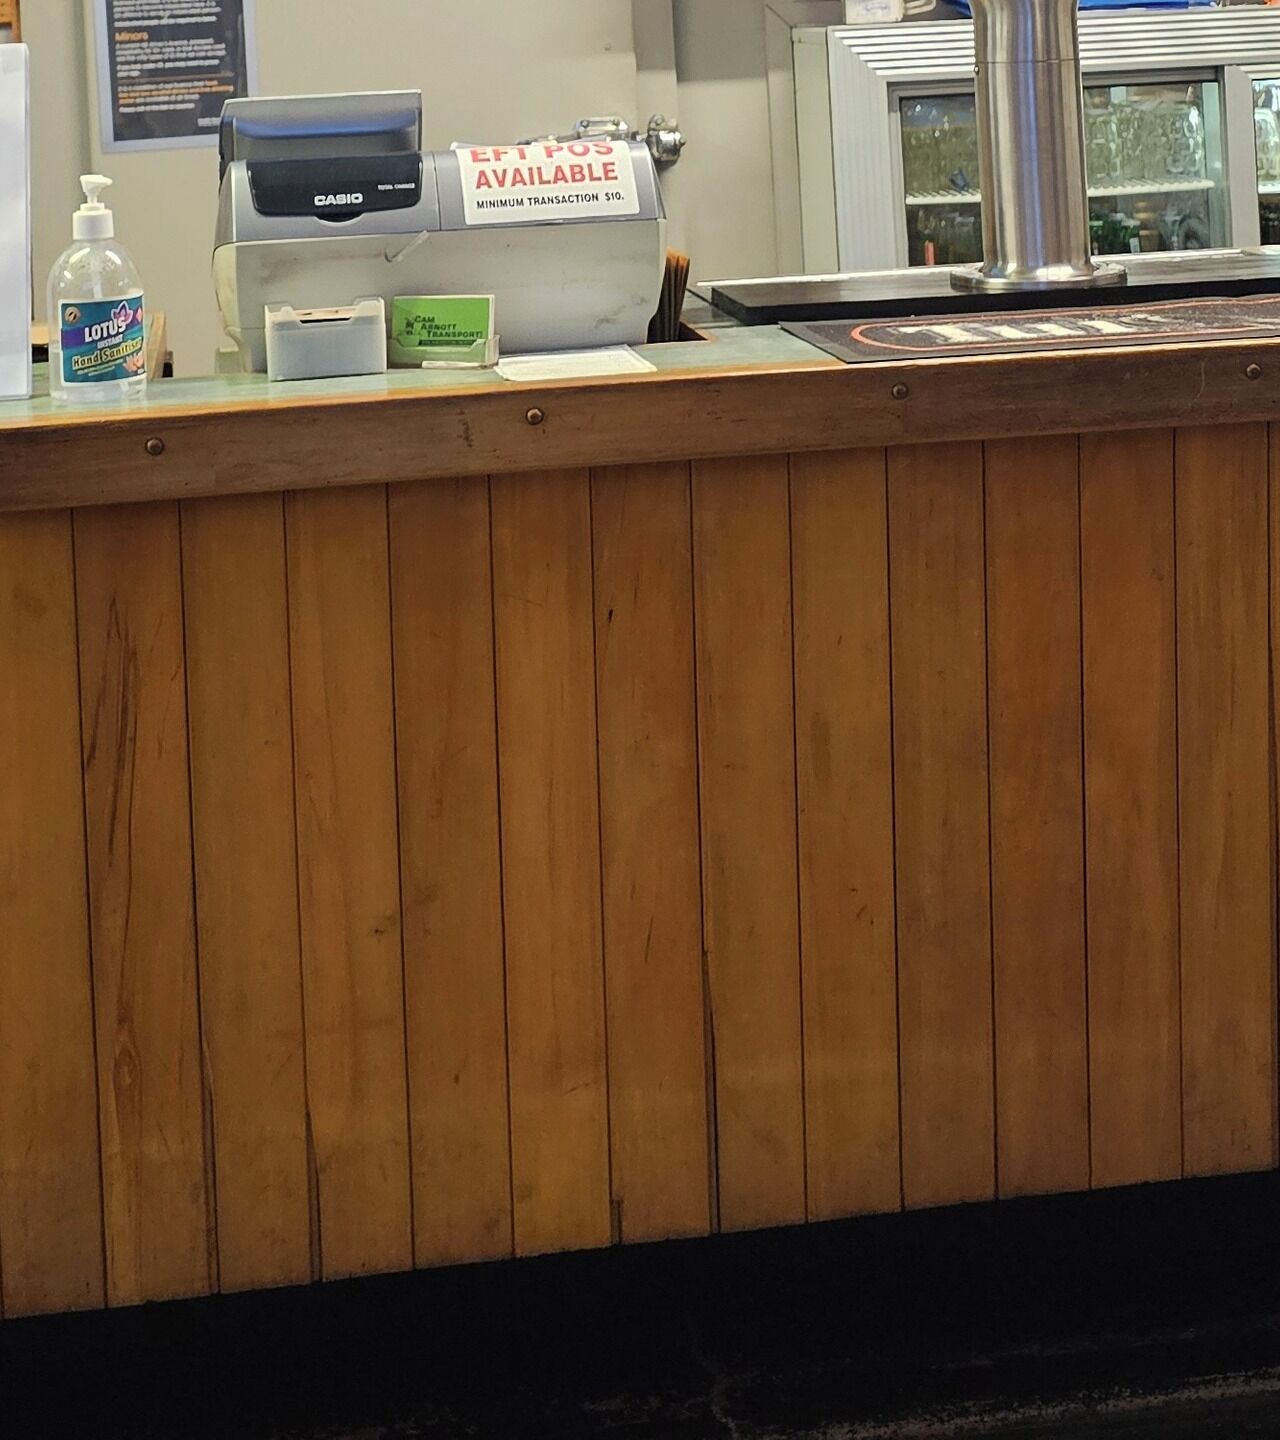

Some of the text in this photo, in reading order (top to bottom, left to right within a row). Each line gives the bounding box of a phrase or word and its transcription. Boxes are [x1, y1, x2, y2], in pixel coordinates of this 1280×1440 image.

[115, 32, 148, 41] Minors
[469, 141, 614, 163] EFT POS
[476, 162, 618, 189] AVAILABLE
[314, 193, 364, 206] CASIO
[476, 191, 625, 209] MINIMUM TRANSACTION $10.
[84, 316, 127, 343] LOTUS
[72, 336, 144, 370] Hand Sanitiser
